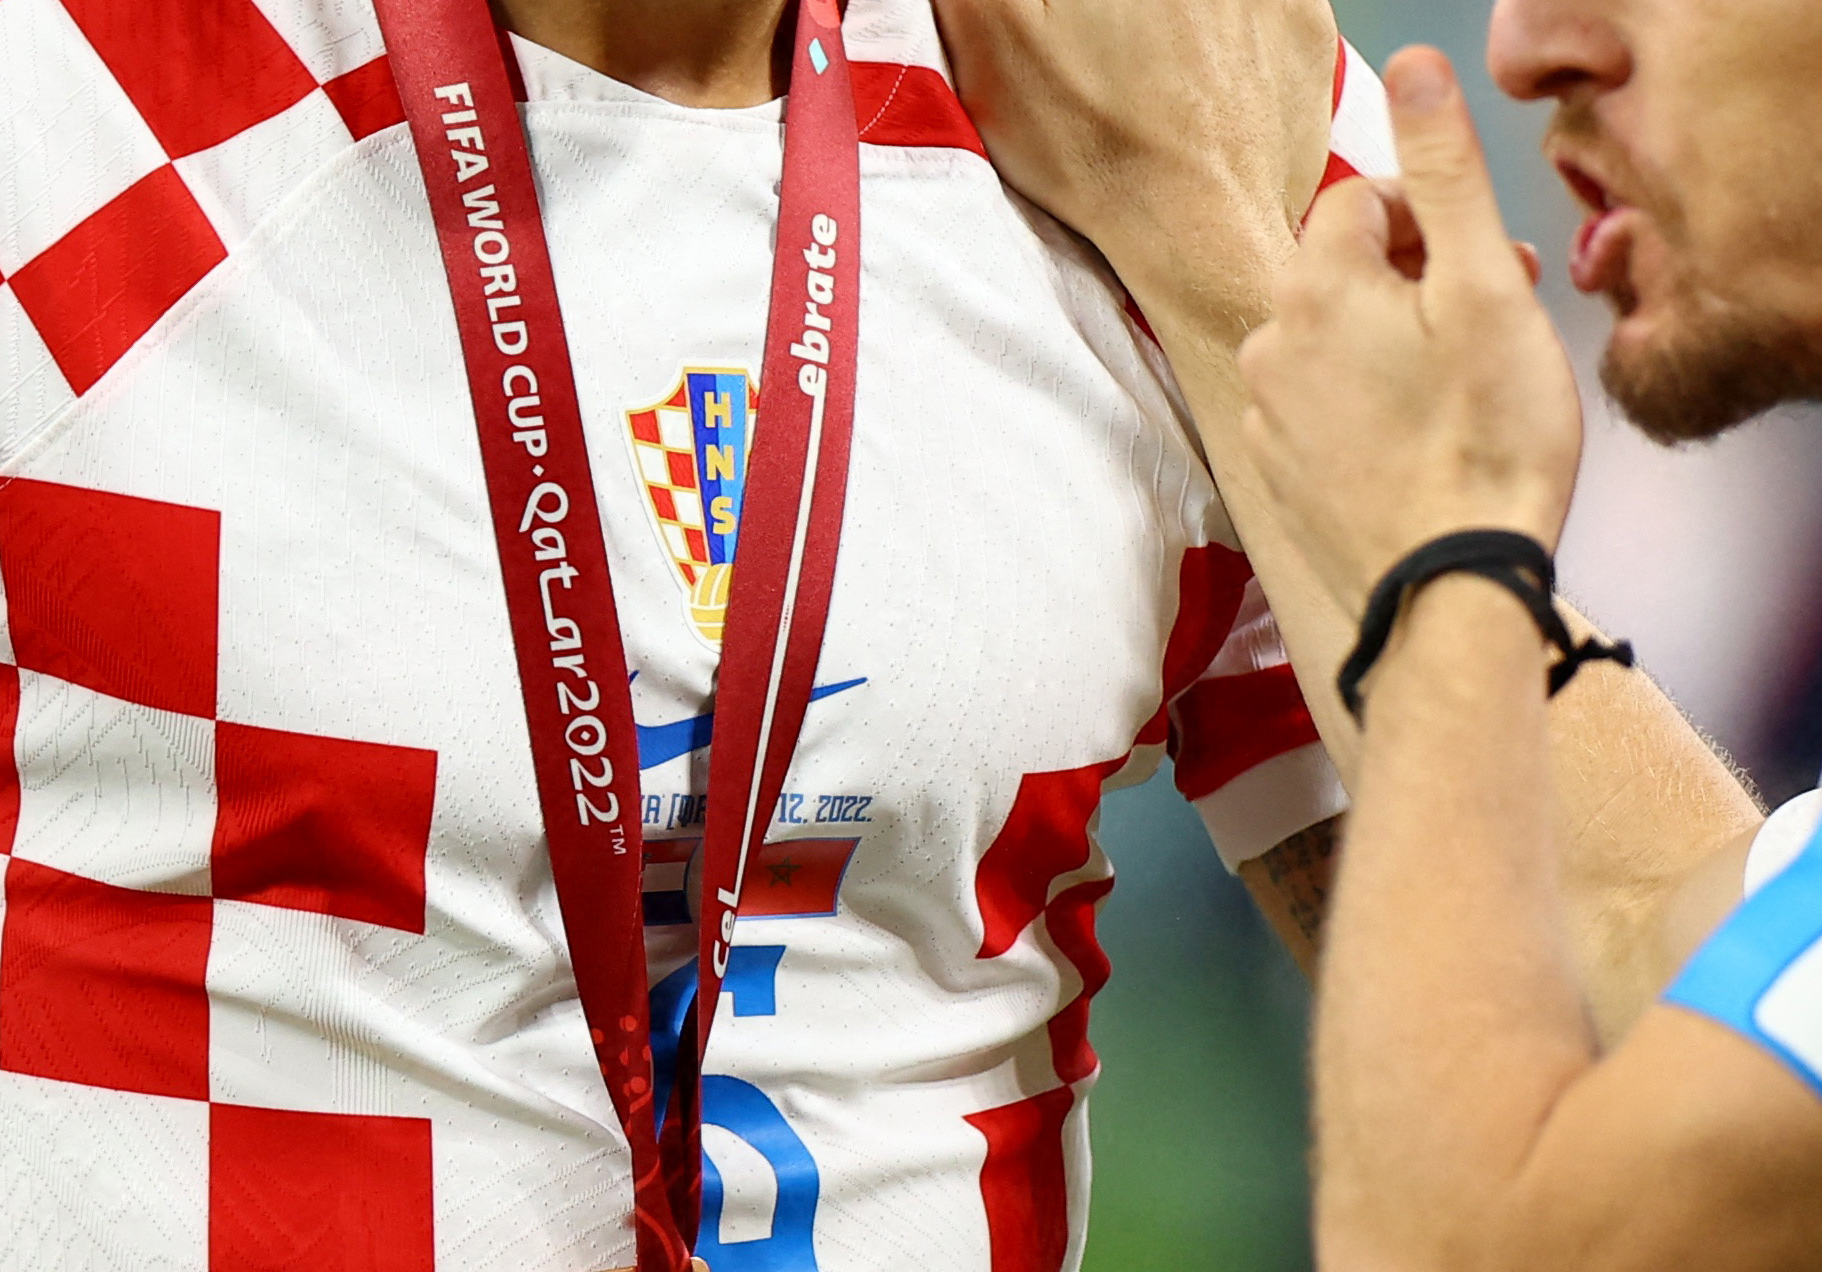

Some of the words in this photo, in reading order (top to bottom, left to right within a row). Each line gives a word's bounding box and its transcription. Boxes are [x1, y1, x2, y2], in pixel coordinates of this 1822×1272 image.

[433, 82, 489, 183] FIFA
[461, 183, 529, 356] WORLD
[503, 364, 548, 457] CUP
[704, 391, 736, 535] HNS
[815, 795, 873, 823] 2022.
